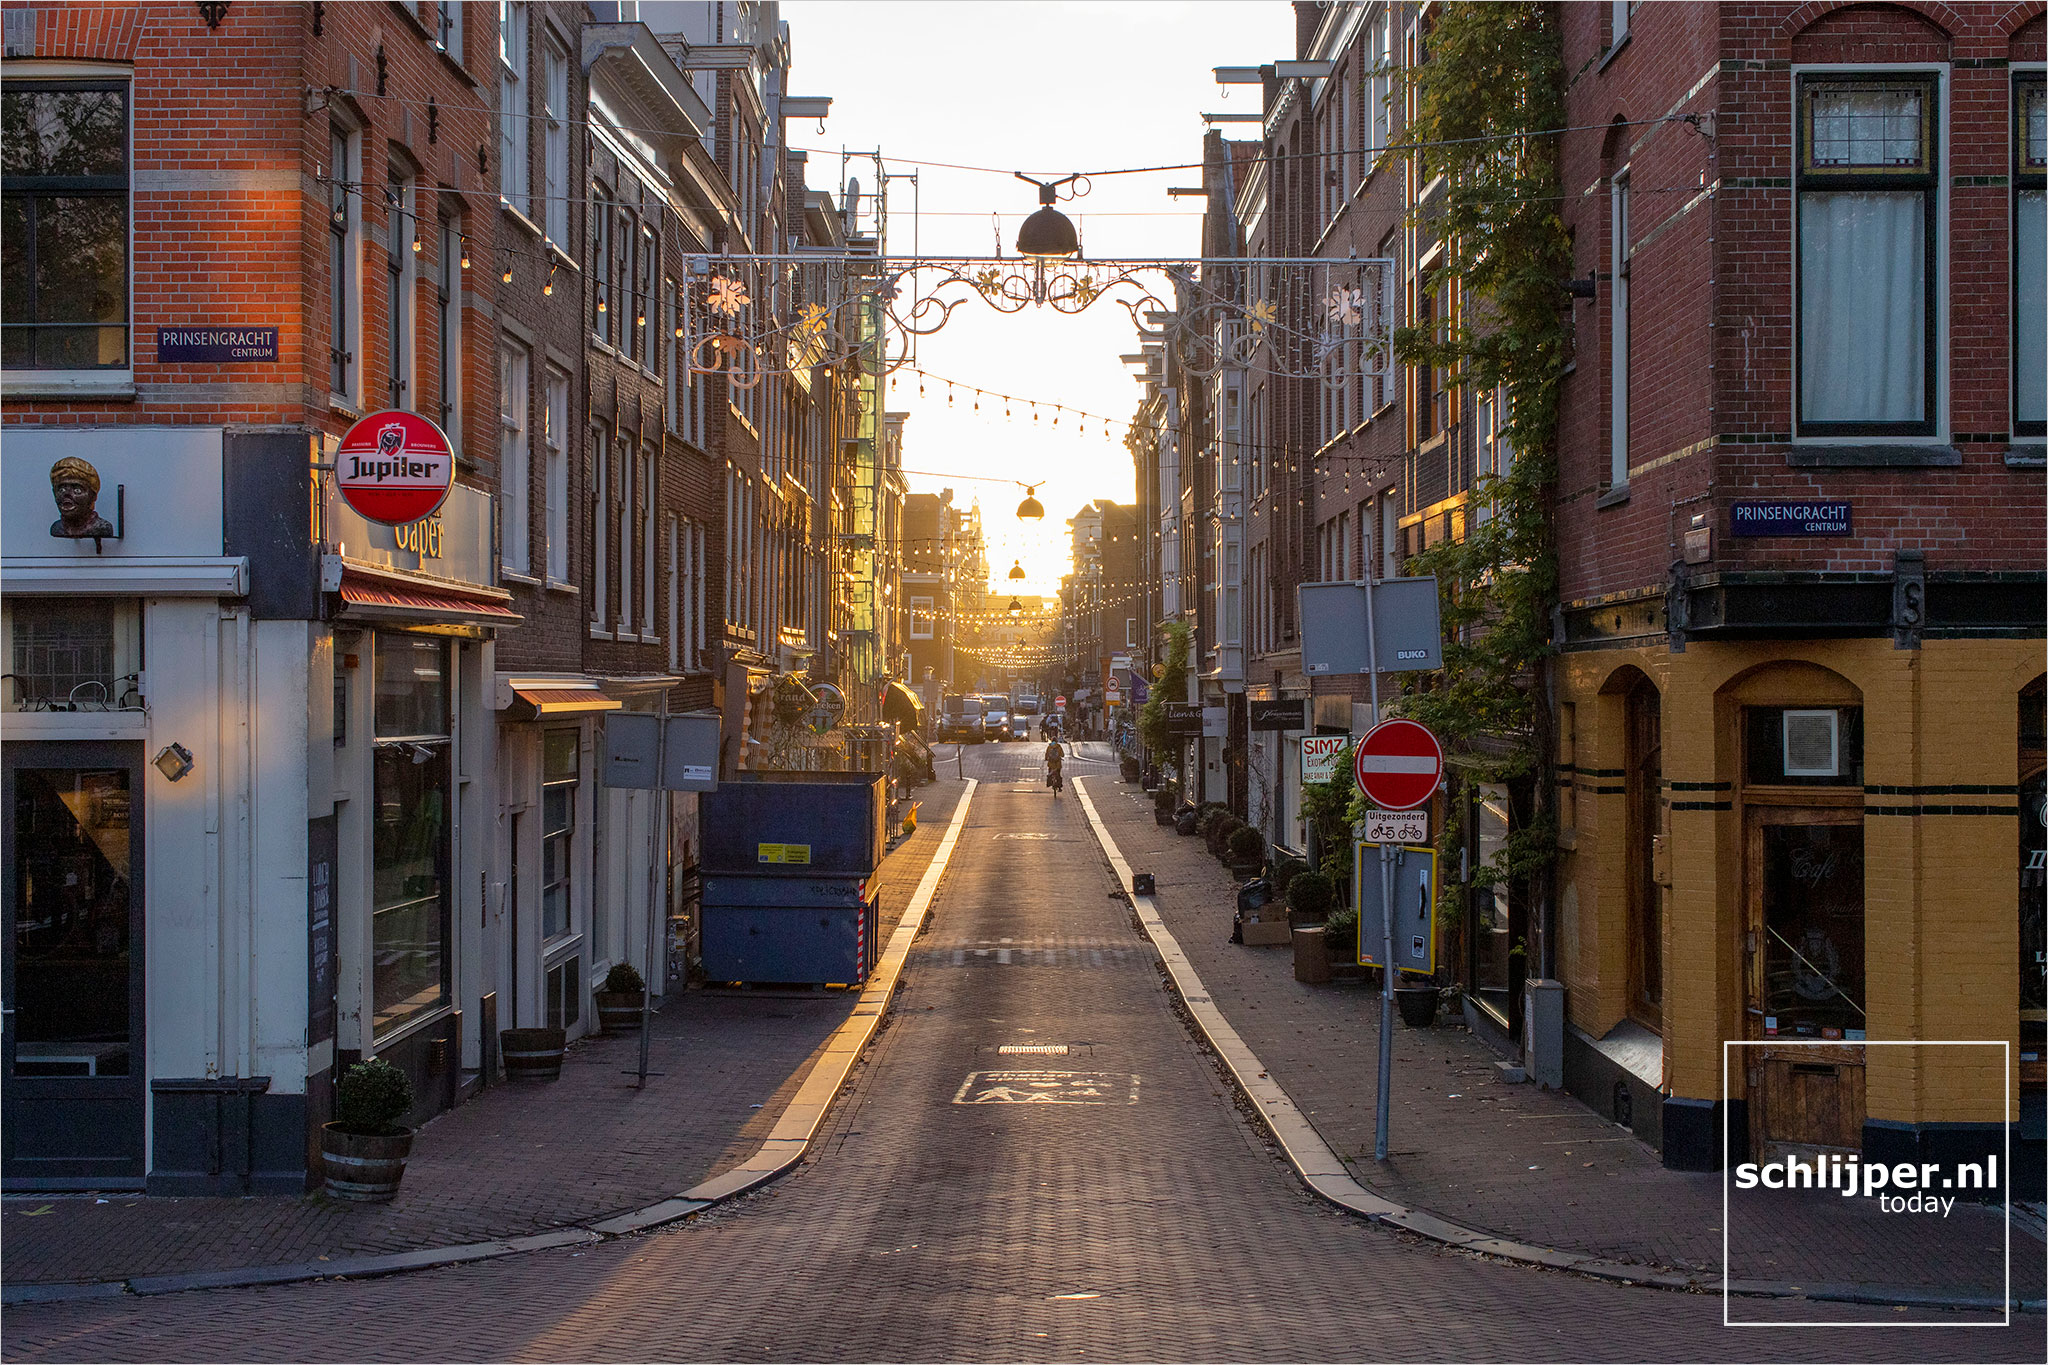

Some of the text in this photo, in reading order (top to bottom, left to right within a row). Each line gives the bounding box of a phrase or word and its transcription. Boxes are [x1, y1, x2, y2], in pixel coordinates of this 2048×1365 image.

[163, 331, 273, 346] PRINSENGRACHT
[231, 348, 273, 358] CENTRUM
[347, 456, 440, 483] Jupiler
[1736, 505, 1847, 520] PRINSENGRACHT
[1804, 522, 1847, 532] CENTRUM
[1304, 738, 1344, 755] SIMZ
[1369, 811, 1425, 822] Uitgezonderd
